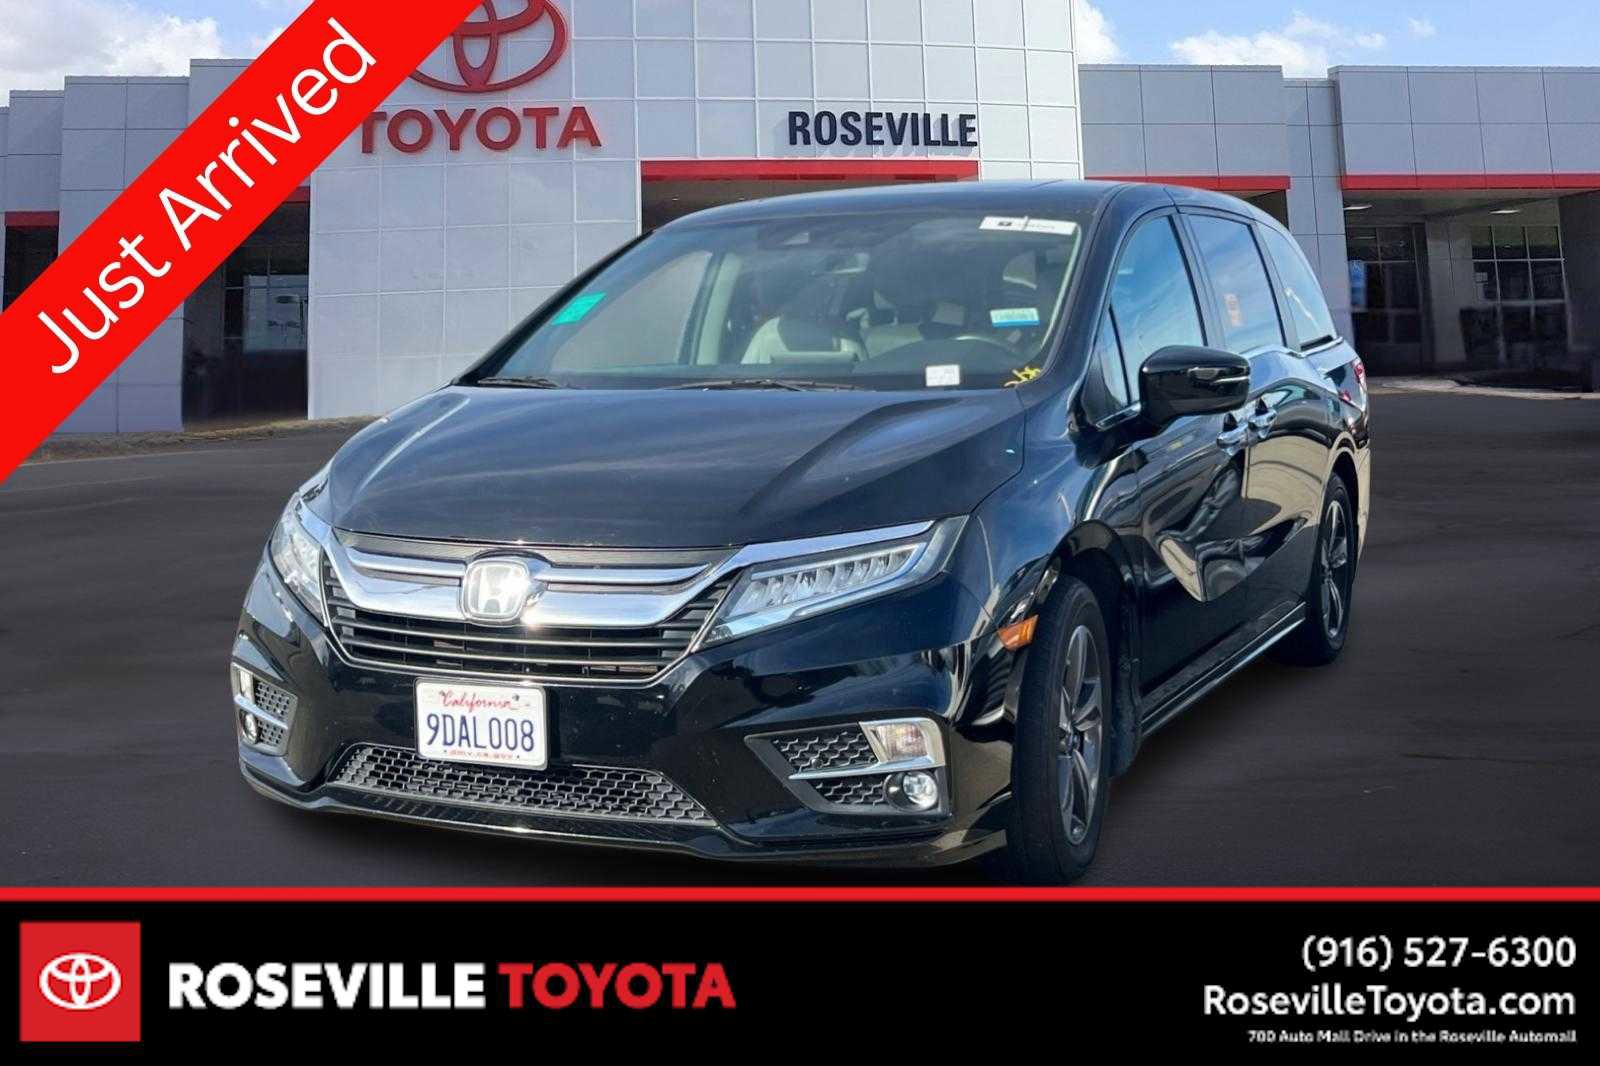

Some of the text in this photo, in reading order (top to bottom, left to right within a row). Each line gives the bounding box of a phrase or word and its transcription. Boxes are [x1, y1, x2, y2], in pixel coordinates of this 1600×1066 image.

[361, 106, 602, 153] TOYOTA
[788, 111, 978, 147] ROSEVILLE
[438, 689, 513, 713] California
[426, 713, 534, 752] 9DAL008
